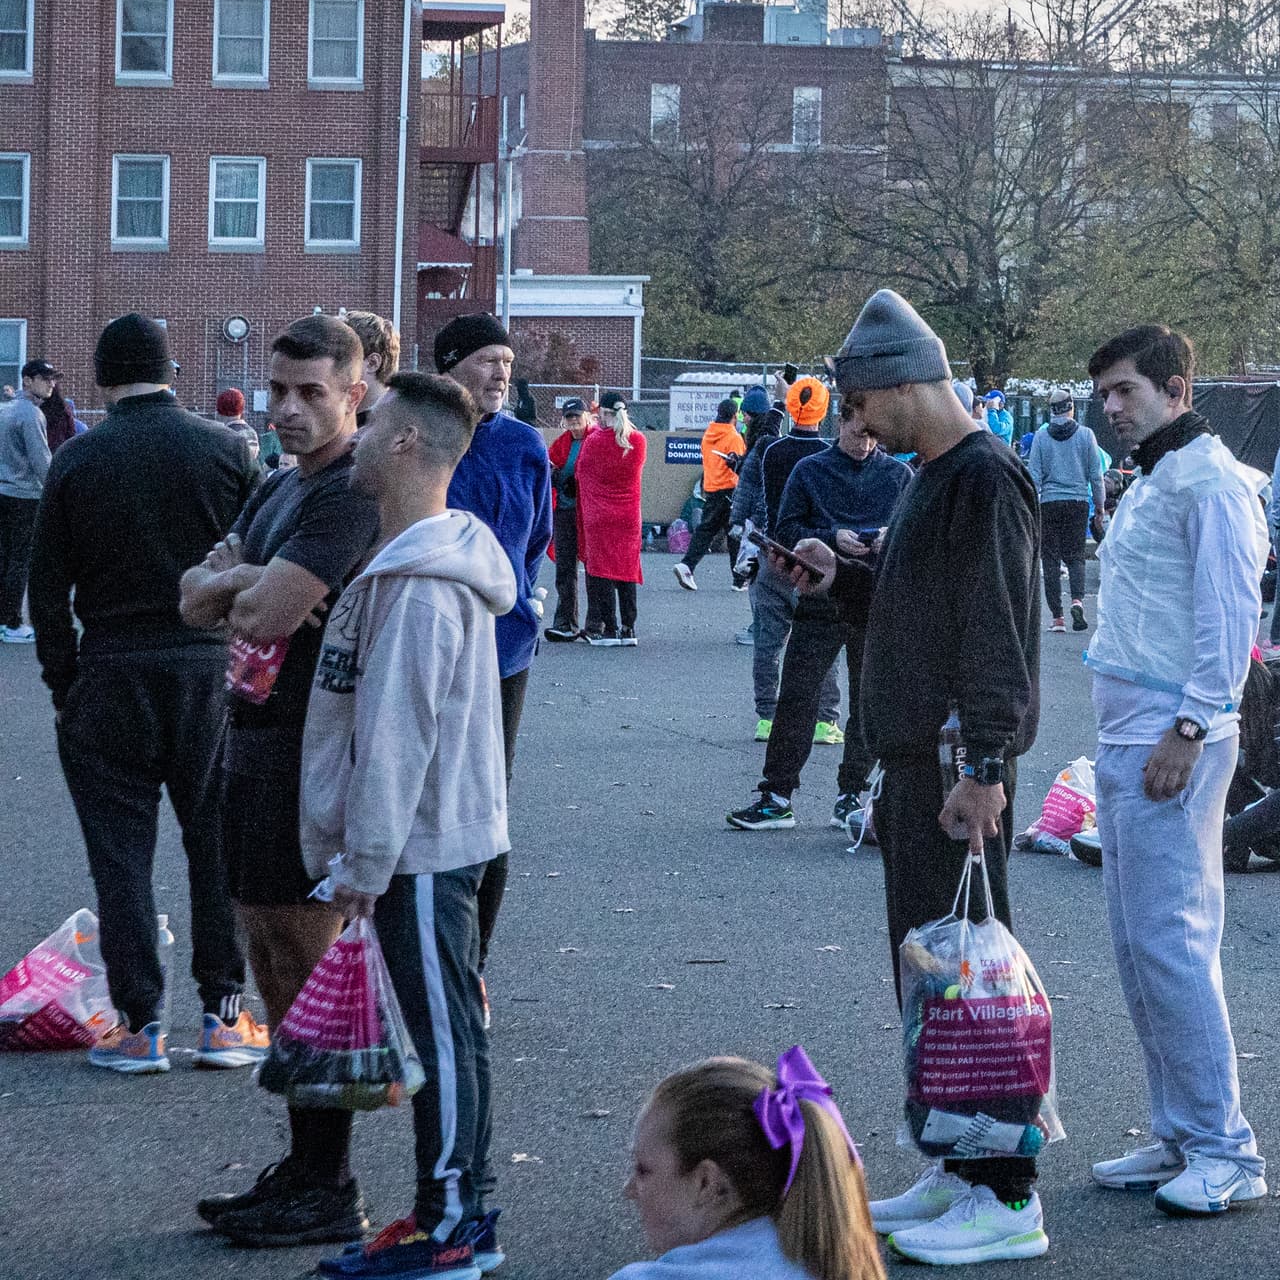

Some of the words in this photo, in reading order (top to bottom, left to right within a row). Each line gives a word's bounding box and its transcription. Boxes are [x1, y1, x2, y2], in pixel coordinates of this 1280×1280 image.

[668, 442, 702, 450] CLOTHIN
[928, 1007, 964, 1020] Start
[968, 1004, 1023, 1020] Village
[926, 1028, 937, 1036] NO
[938, 1028, 972, 1037] transport
[983, 1027, 997, 1035] the
[998, 1025, 1018, 1034] finish
[925, 1043, 936, 1051] NO
[960, 1040, 1009, 1051] transportado
[958, 1055, 974, 1064] PAS
[923, 1071, 941, 1079] NON
[922, 1085, 944, 1094] WIRD
[945, 1084, 970, 1093] NICHT
